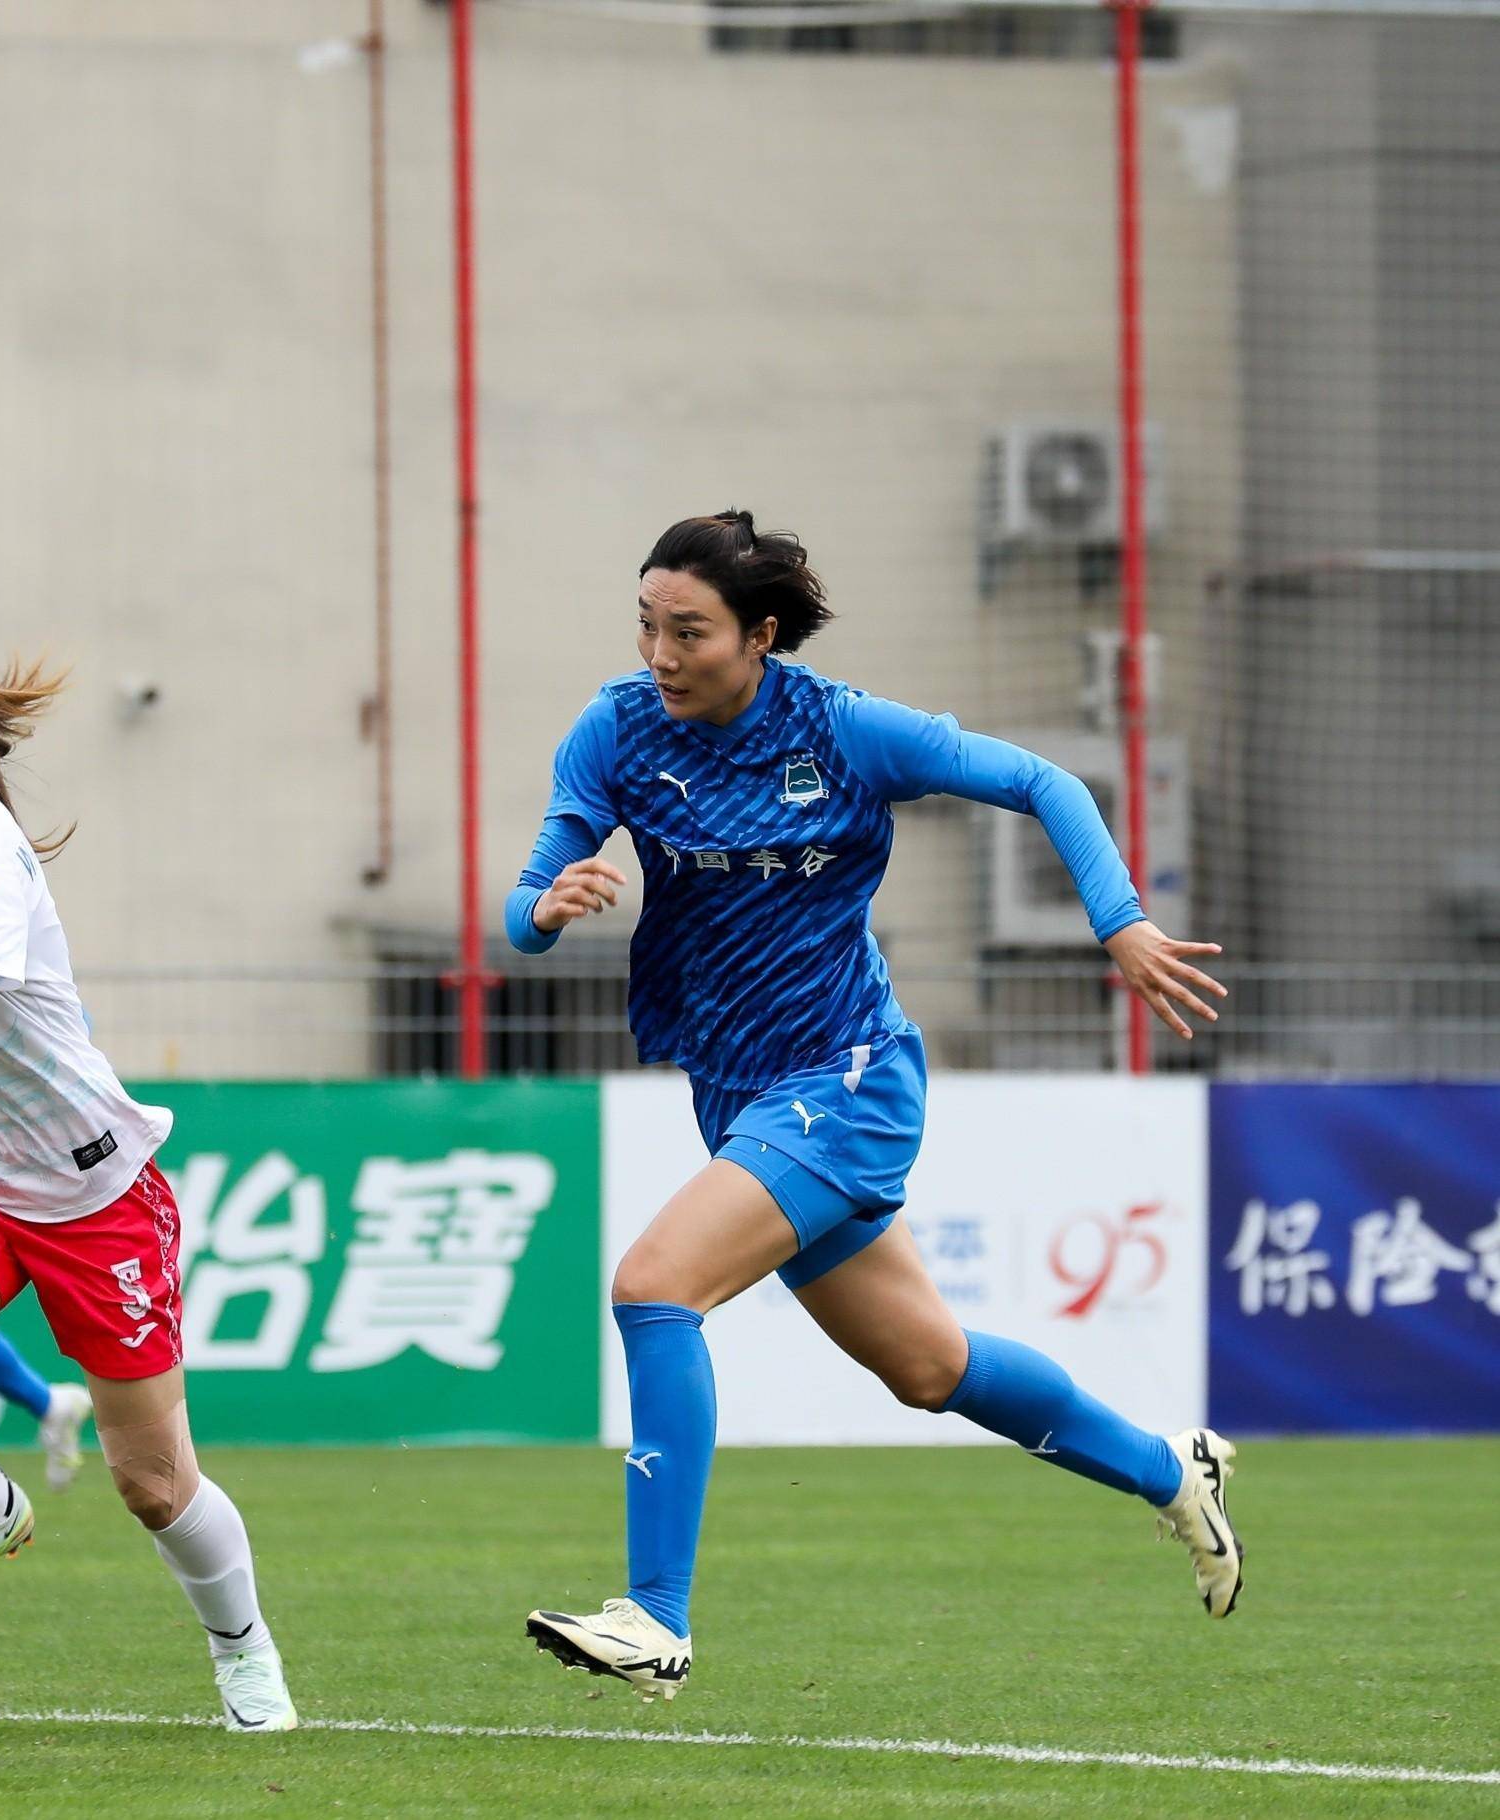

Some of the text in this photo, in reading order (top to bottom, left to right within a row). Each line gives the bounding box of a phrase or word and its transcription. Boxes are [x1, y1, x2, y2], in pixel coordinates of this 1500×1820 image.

[110, 1257, 152, 1321] 5
[170, 1148, 558, 1373] 怡寶
[1048, 1202, 1167, 1321] 95
[1224, 1195, 1500, 1317] 保险
